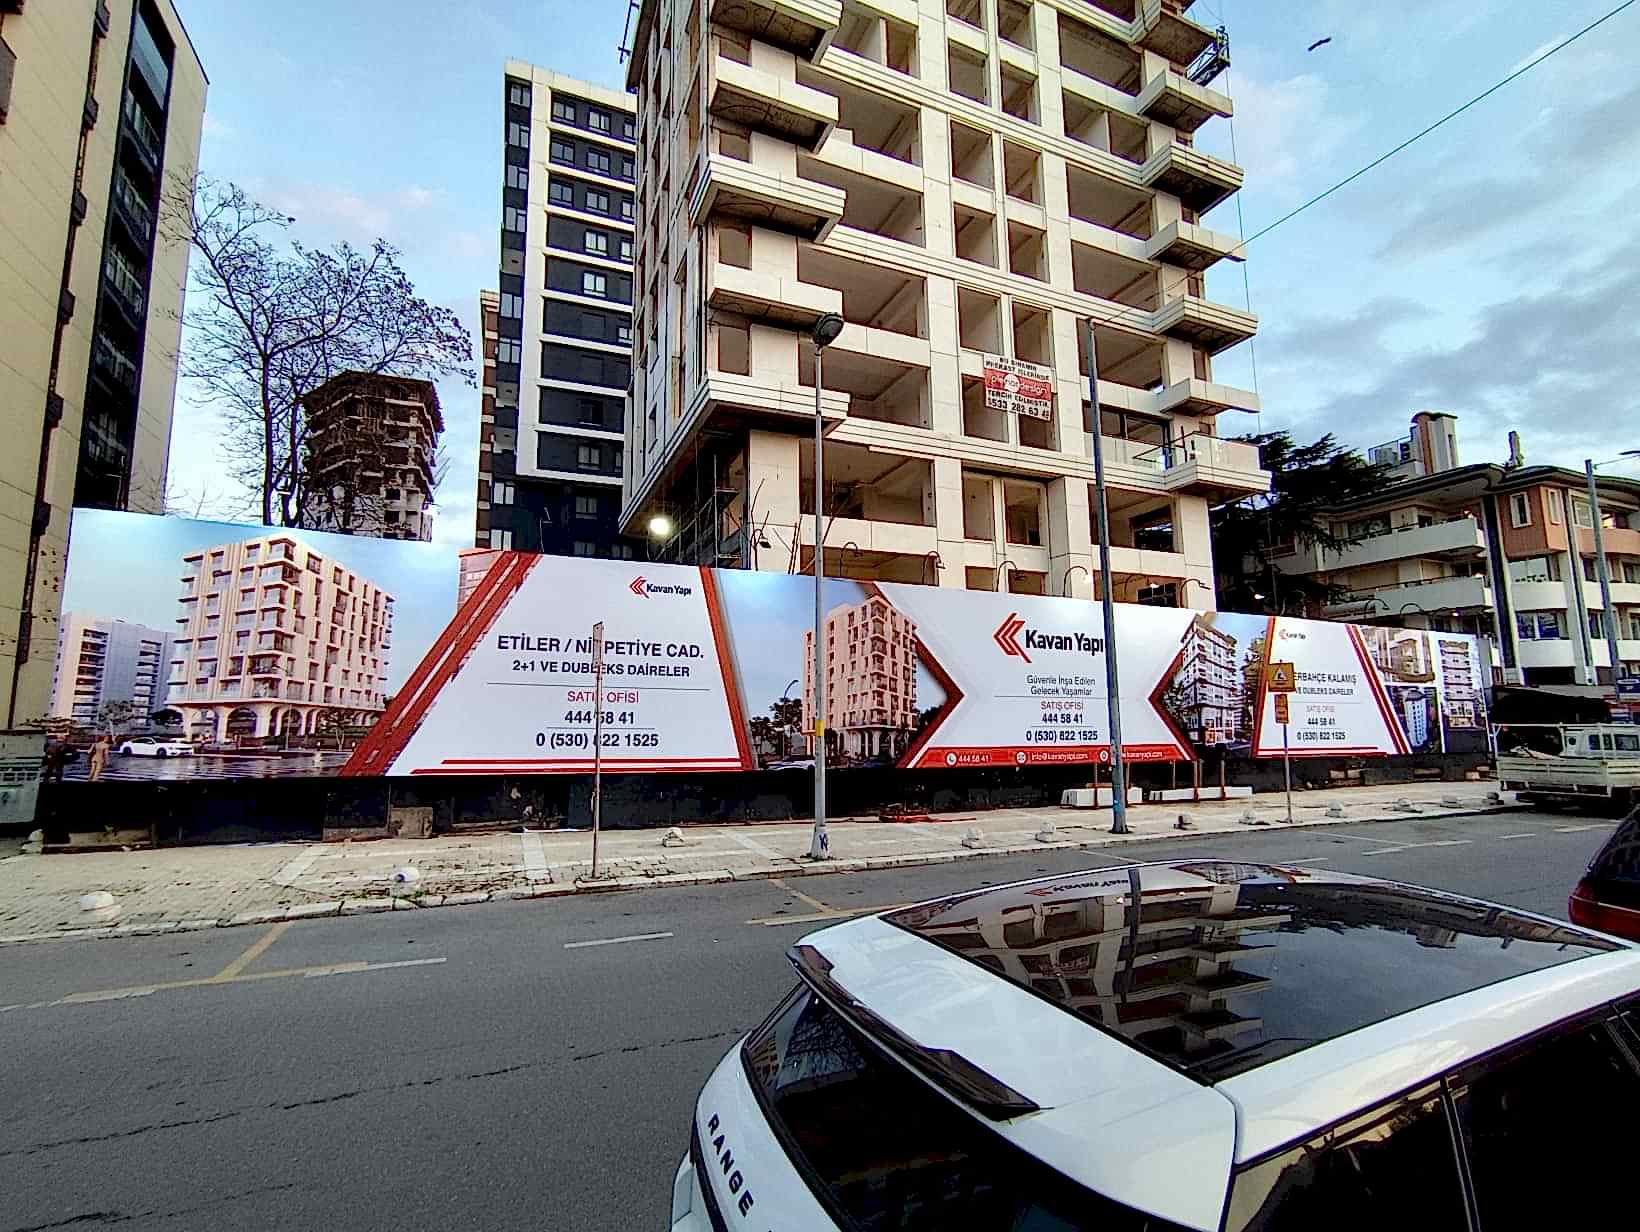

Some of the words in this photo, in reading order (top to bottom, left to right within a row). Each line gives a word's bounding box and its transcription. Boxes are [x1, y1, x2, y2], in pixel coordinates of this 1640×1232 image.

[647, 583, 674, 593] Kavan
[498, 633, 560, 652] ETİLER
[564, 639, 571, 653] /
[575, 637, 661, 657] NİPETİYE
[666, 644, 704, 658] CAD.
[1025, 629, 1072, 650] Kavan
[1074, 633, 1104, 656] Yapı
[512, 660, 535, 672] 2+1
[540, 661, 558, 672] VE
[627, 663, 690, 677] DAİRELER
[568, 691, 602, 703] SATI
[607, 690, 639, 703] OFİSİ
[565, 711, 592, 724] 444
[619, 711, 634, 724] 41
[1042, 713, 1058, 724] 444
[1060, 713, 1071, 724] 58
[1074, 713, 1083, 724] 41
[536, 733, 546, 746] 0
[550, 733, 588, 749] (530)
[625, 734, 659, 747] 1525
[1026, 731, 1032, 741] 0
[1034, 730, 1057, 743] (530)
[1079, 731, 1098, 741] 1525
[708, 1113, 754, 1218] RANGE
